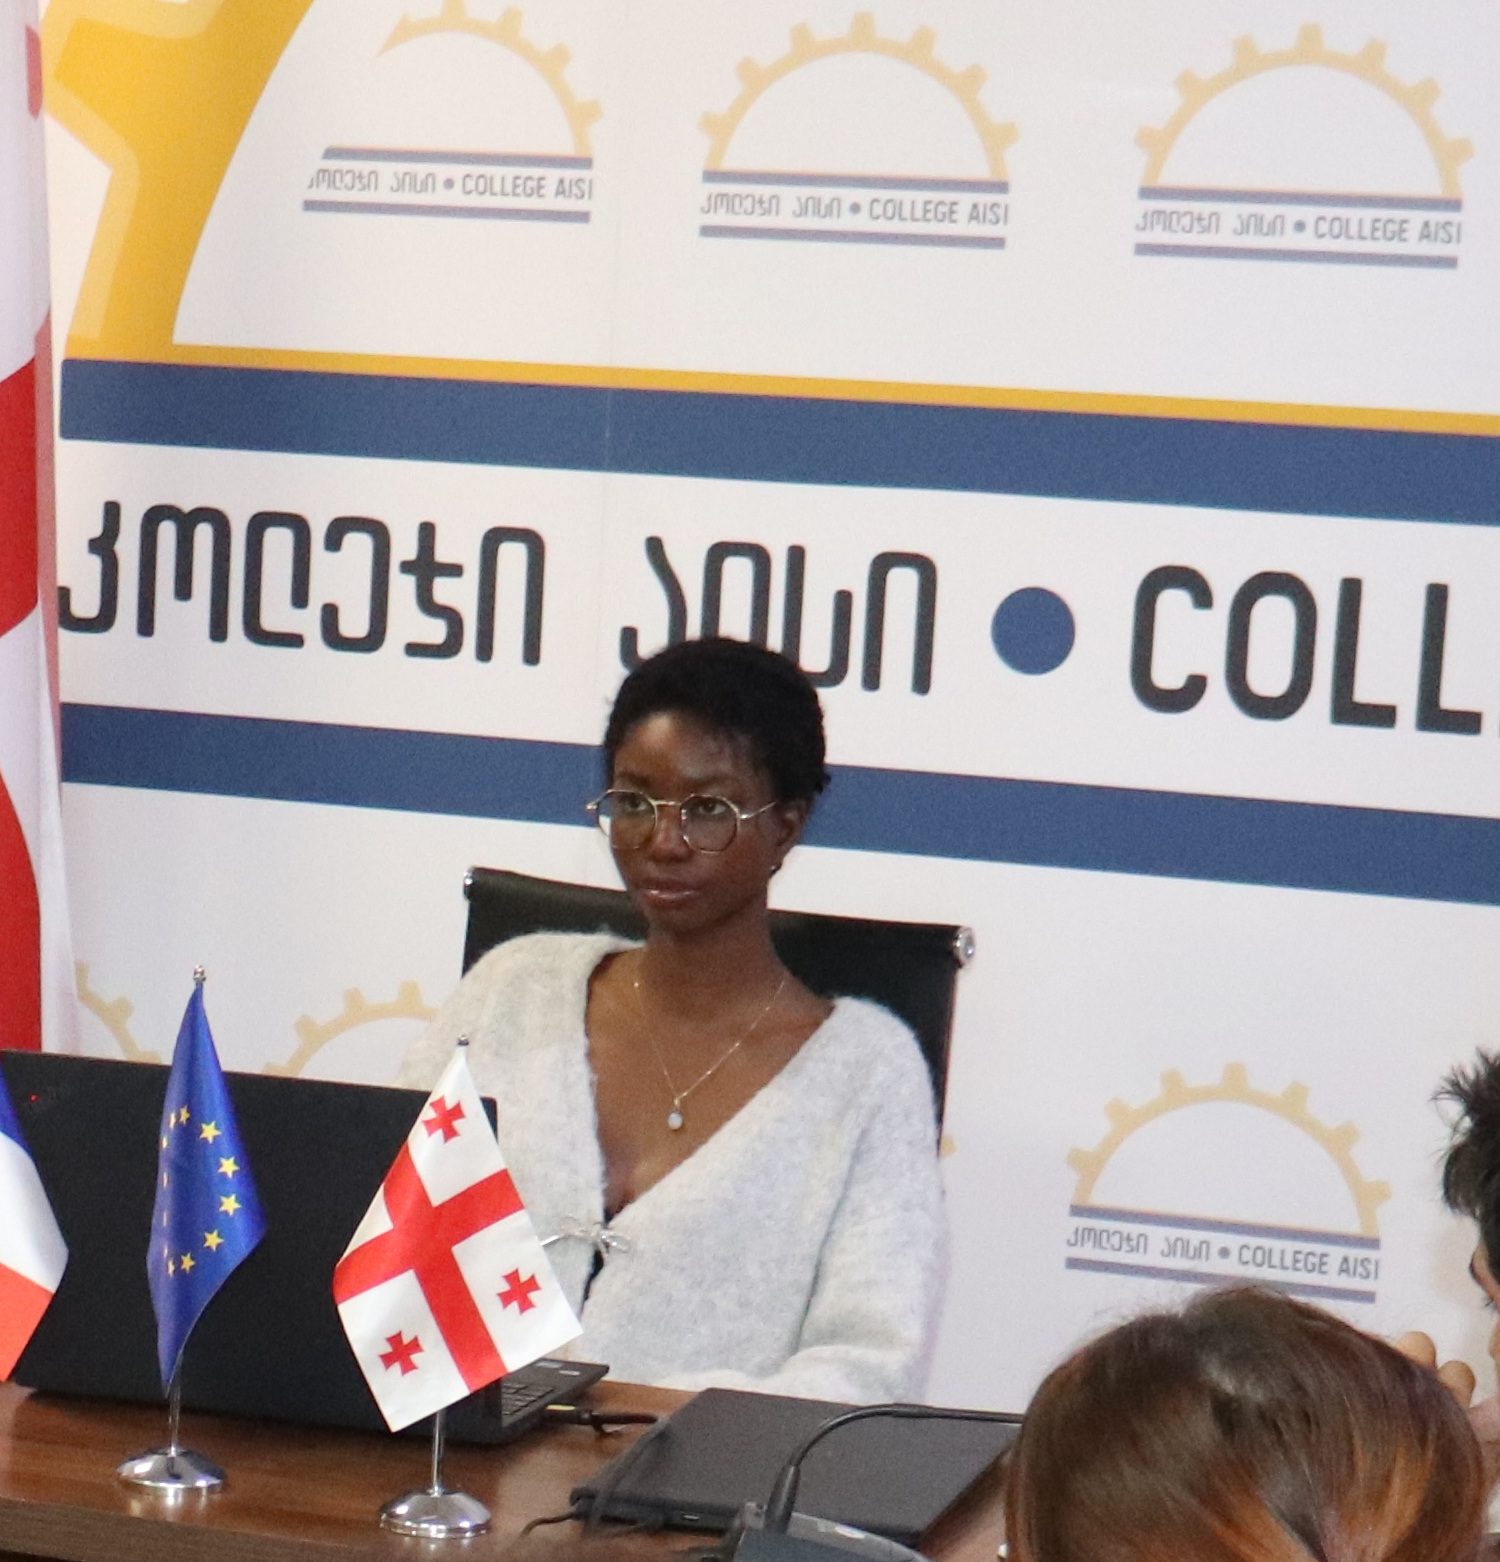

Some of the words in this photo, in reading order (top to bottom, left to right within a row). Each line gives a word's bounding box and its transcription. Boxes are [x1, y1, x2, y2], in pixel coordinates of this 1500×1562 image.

[390, 170, 436, 194] აისი
[462, 173, 546, 198] COLLEGE
[554, 176, 593, 200] AISI
[700, 192, 780, 217] კოლეჯი
[792, 195, 842, 220] აისი
[870, 198, 958, 224] COLLEGE
[968, 201, 1009, 226] AISI
[1135, 209, 1220, 234] კოლეჯი
[1233, 212, 1285, 237] აისი
[1314, 215, 1408, 243] COLLEGE
[1418, 218, 1462, 245] AISI
[57, 500, 545, 667] კოლეჯი
[620, 535, 938, 695] აისი
[1067, 1226, 1148, 1255] კოლეჯი
[1160, 1236, 1210, 1262] აისი
[1238, 1244, 1329, 1275] COLLEGE
[1338, 1254, 1379, 1281] AISI
